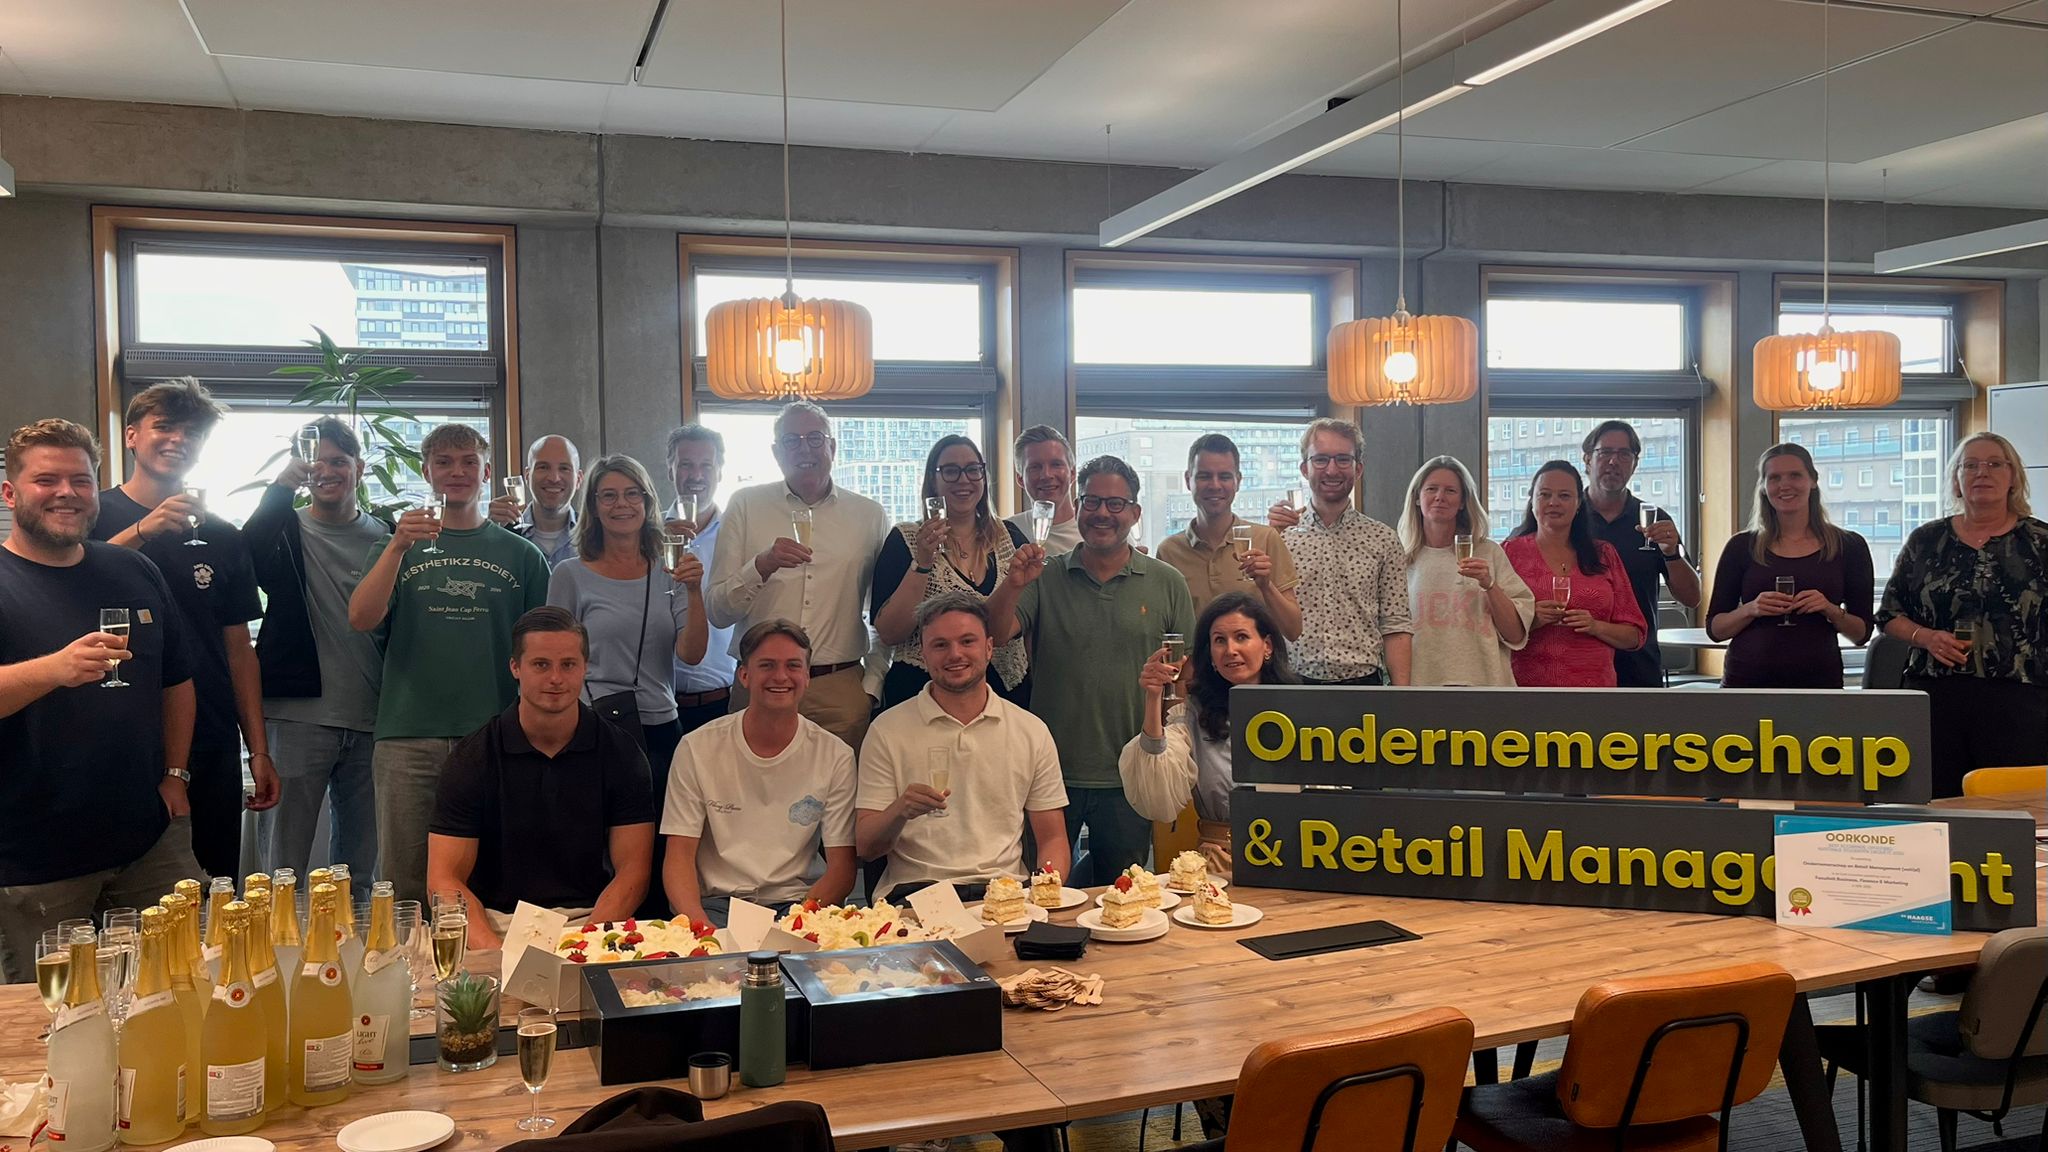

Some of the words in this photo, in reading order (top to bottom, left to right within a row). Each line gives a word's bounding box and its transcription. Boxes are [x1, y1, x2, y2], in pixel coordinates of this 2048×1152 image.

[402, 557, 471, 584] AESTHETIKZ
[473, 558, 520, 589] SOCIETY
[1245, 710, 1911, 791] Ondernemerschap
[1244, 818, 1284, 867] &
[1299, 819, 1484, 878] Retail
[1507, 828, 2015, 906] Managnt
[1825, 832, 1896, 845] OORKONDE
